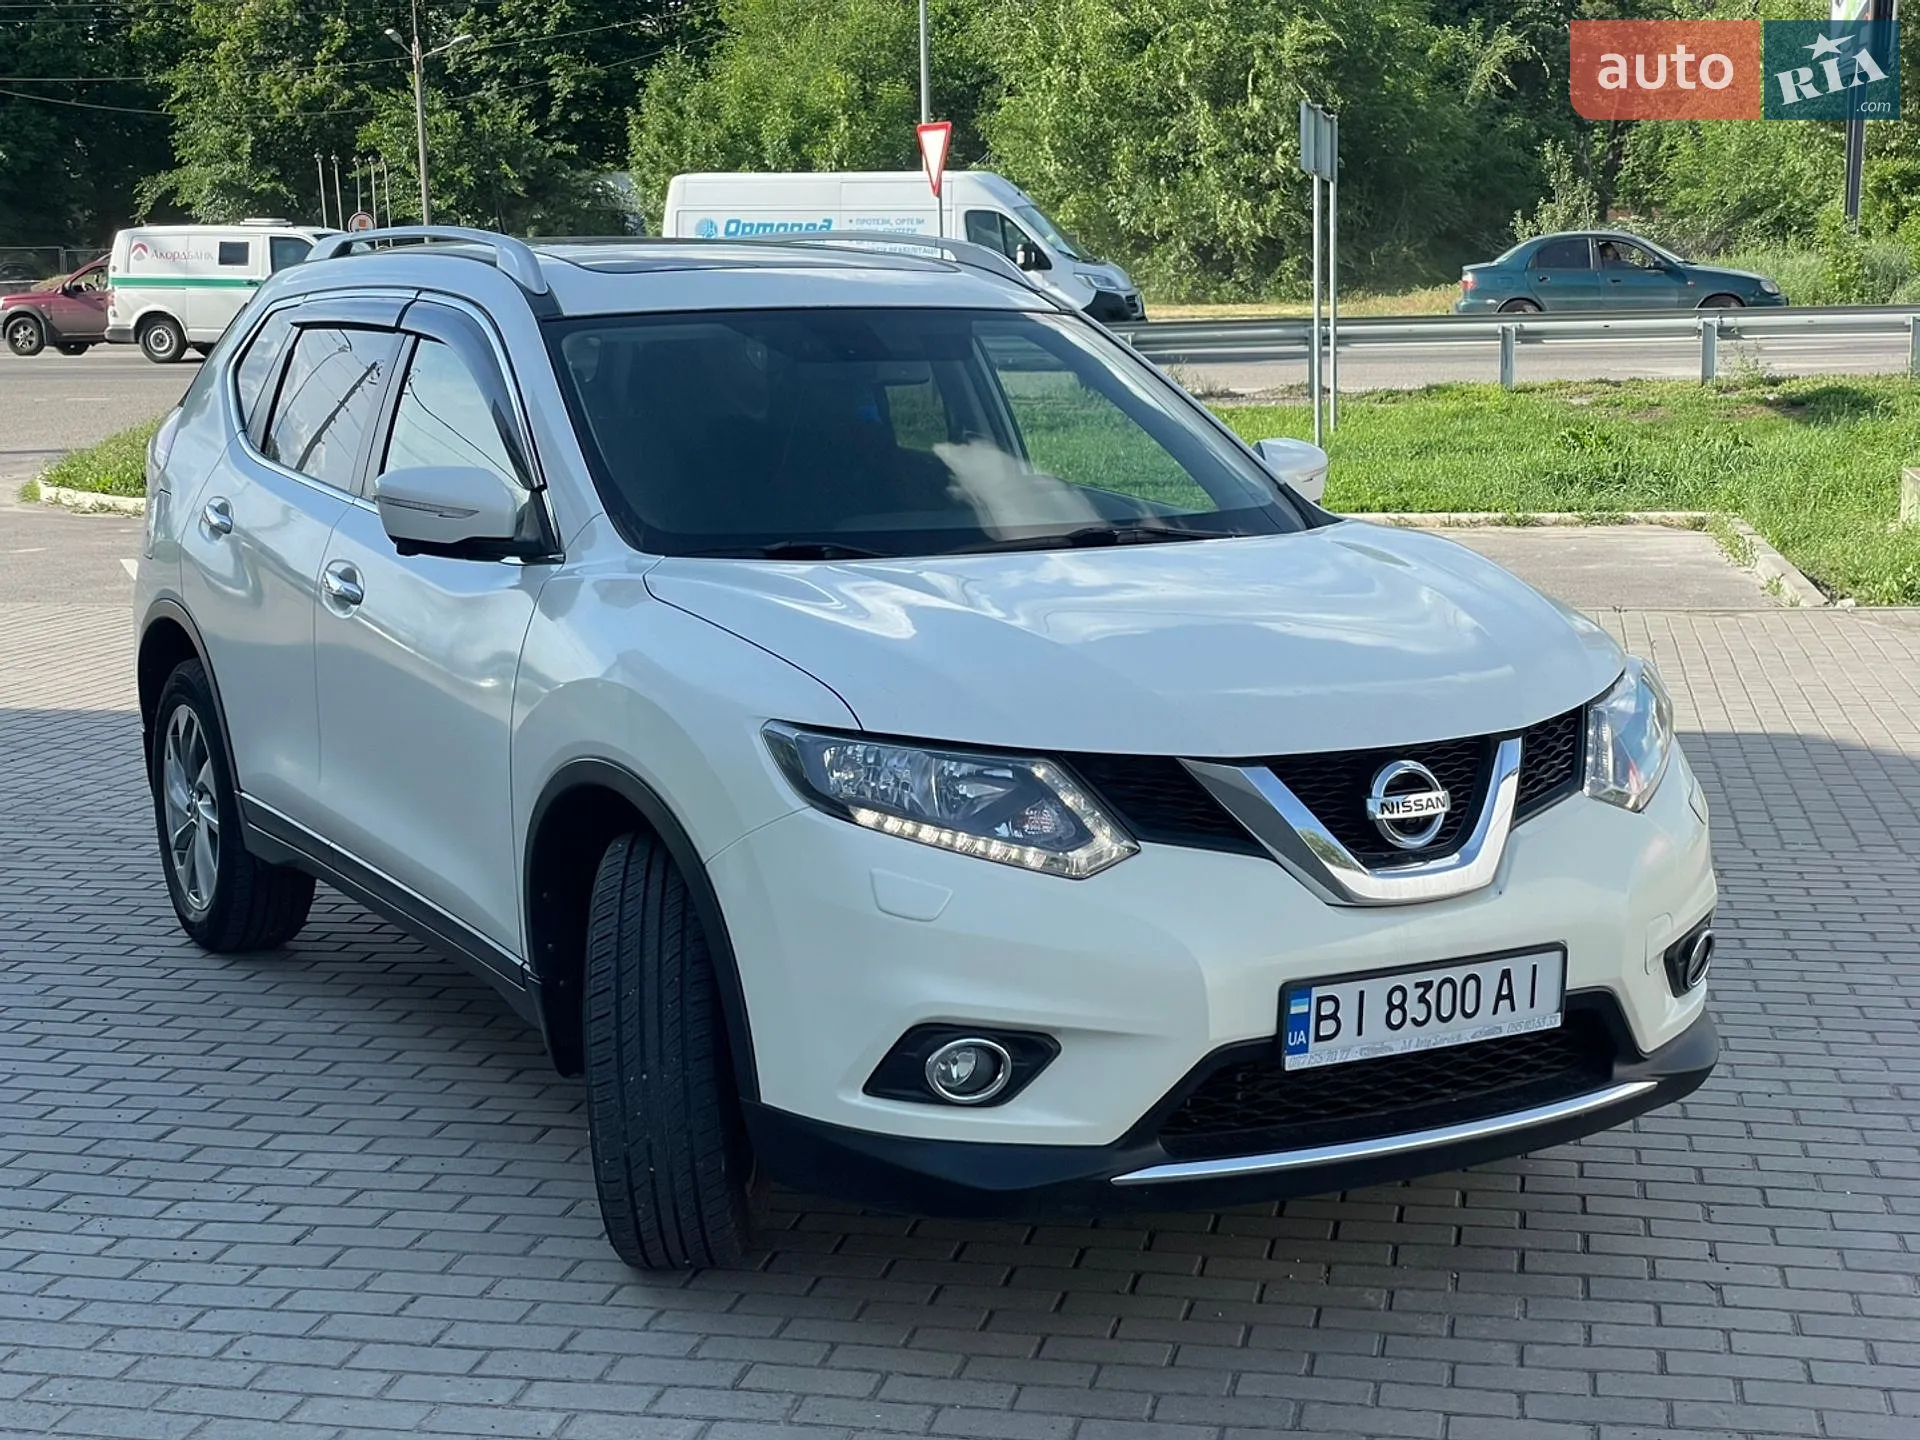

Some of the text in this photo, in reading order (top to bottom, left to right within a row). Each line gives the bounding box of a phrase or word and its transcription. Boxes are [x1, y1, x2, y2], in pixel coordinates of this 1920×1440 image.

[1380, 795, 1446, 815] NISSAN
[1385, 973, 1482, 1031] 8300
[1288, 1030, 1307, 1046] UA
